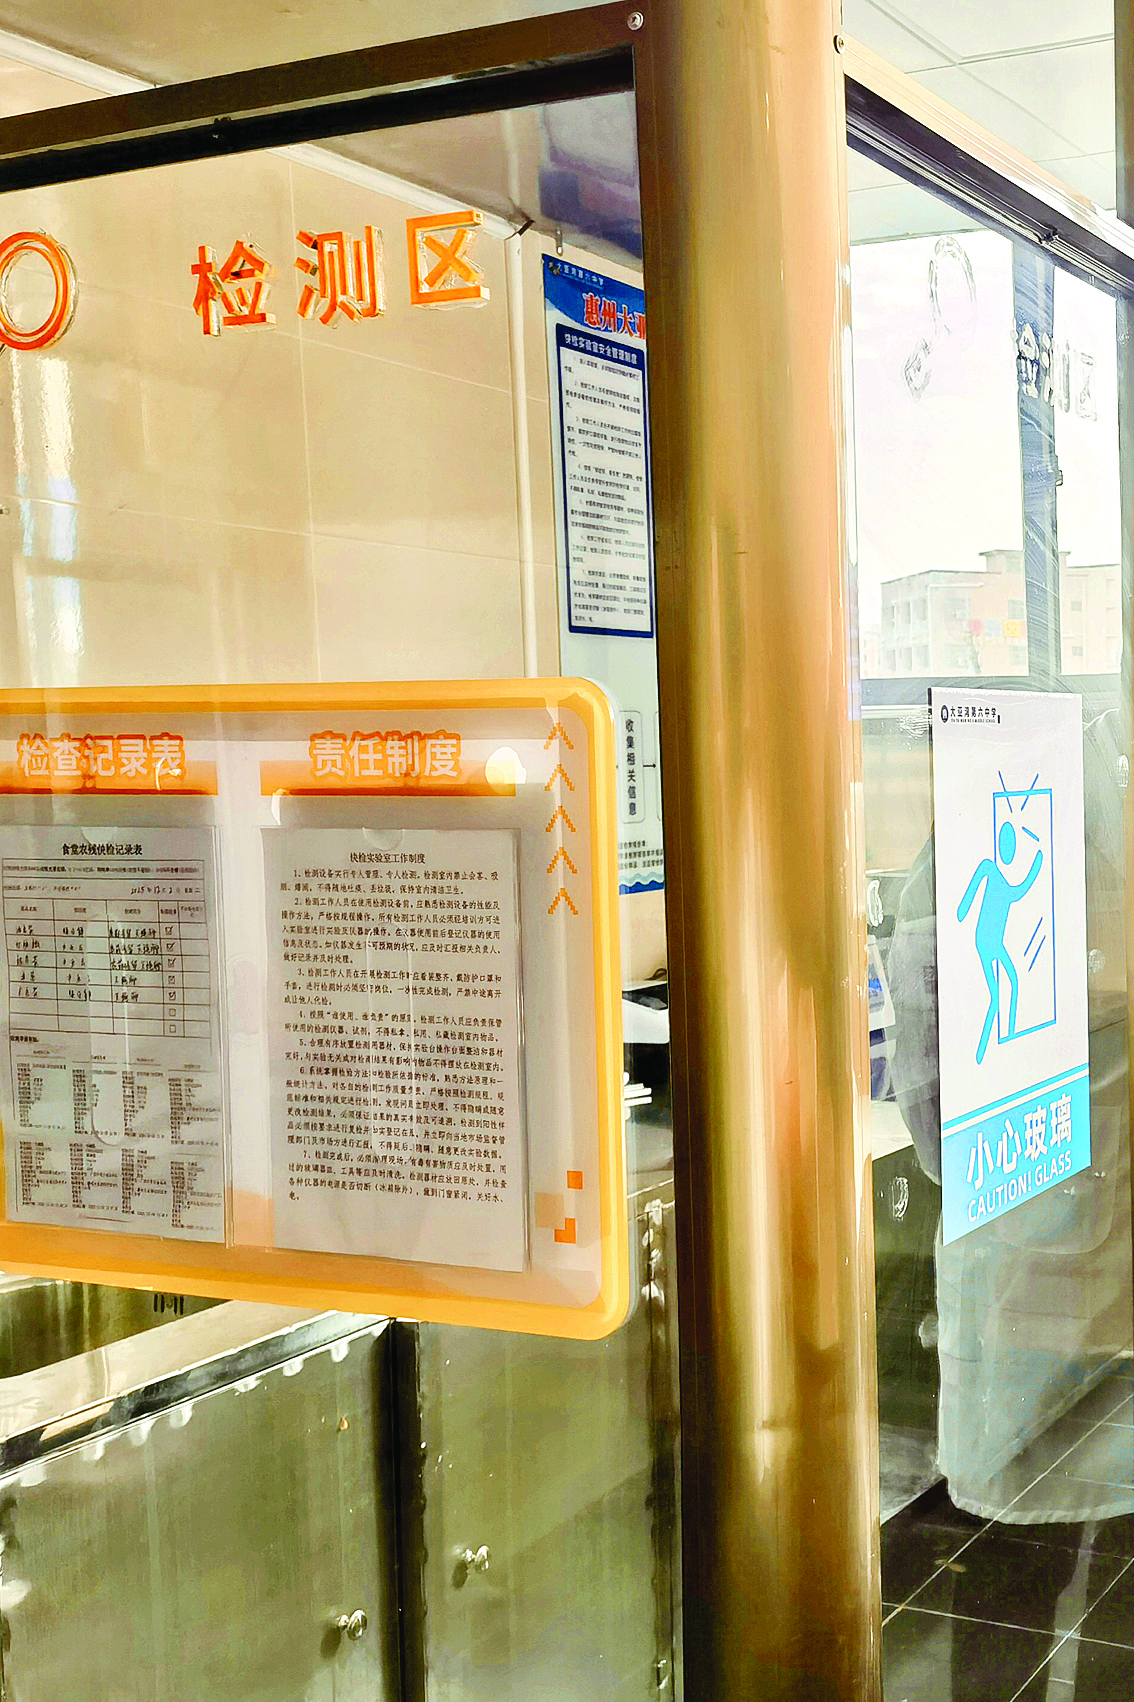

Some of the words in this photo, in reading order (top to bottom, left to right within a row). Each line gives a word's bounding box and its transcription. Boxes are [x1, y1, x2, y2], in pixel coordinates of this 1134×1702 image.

[191, 209, 487, 337] 检测区
[19, 735, 184, 779] 检查记录表
[311, 735, 459, 778] 责任制度
[625, 718, 637, 816] 收集相关信息
[61, 842, 143, 856] 食堂农残快检记录表
[349, 851, 426, 864] 快检实验室工作制度
[966, 1093, 1072, 1191] 小心玻璃
[967, 1170, 1032, 1222] CAUTION!
[1034, 1149, 1072, 1187] GLASS
